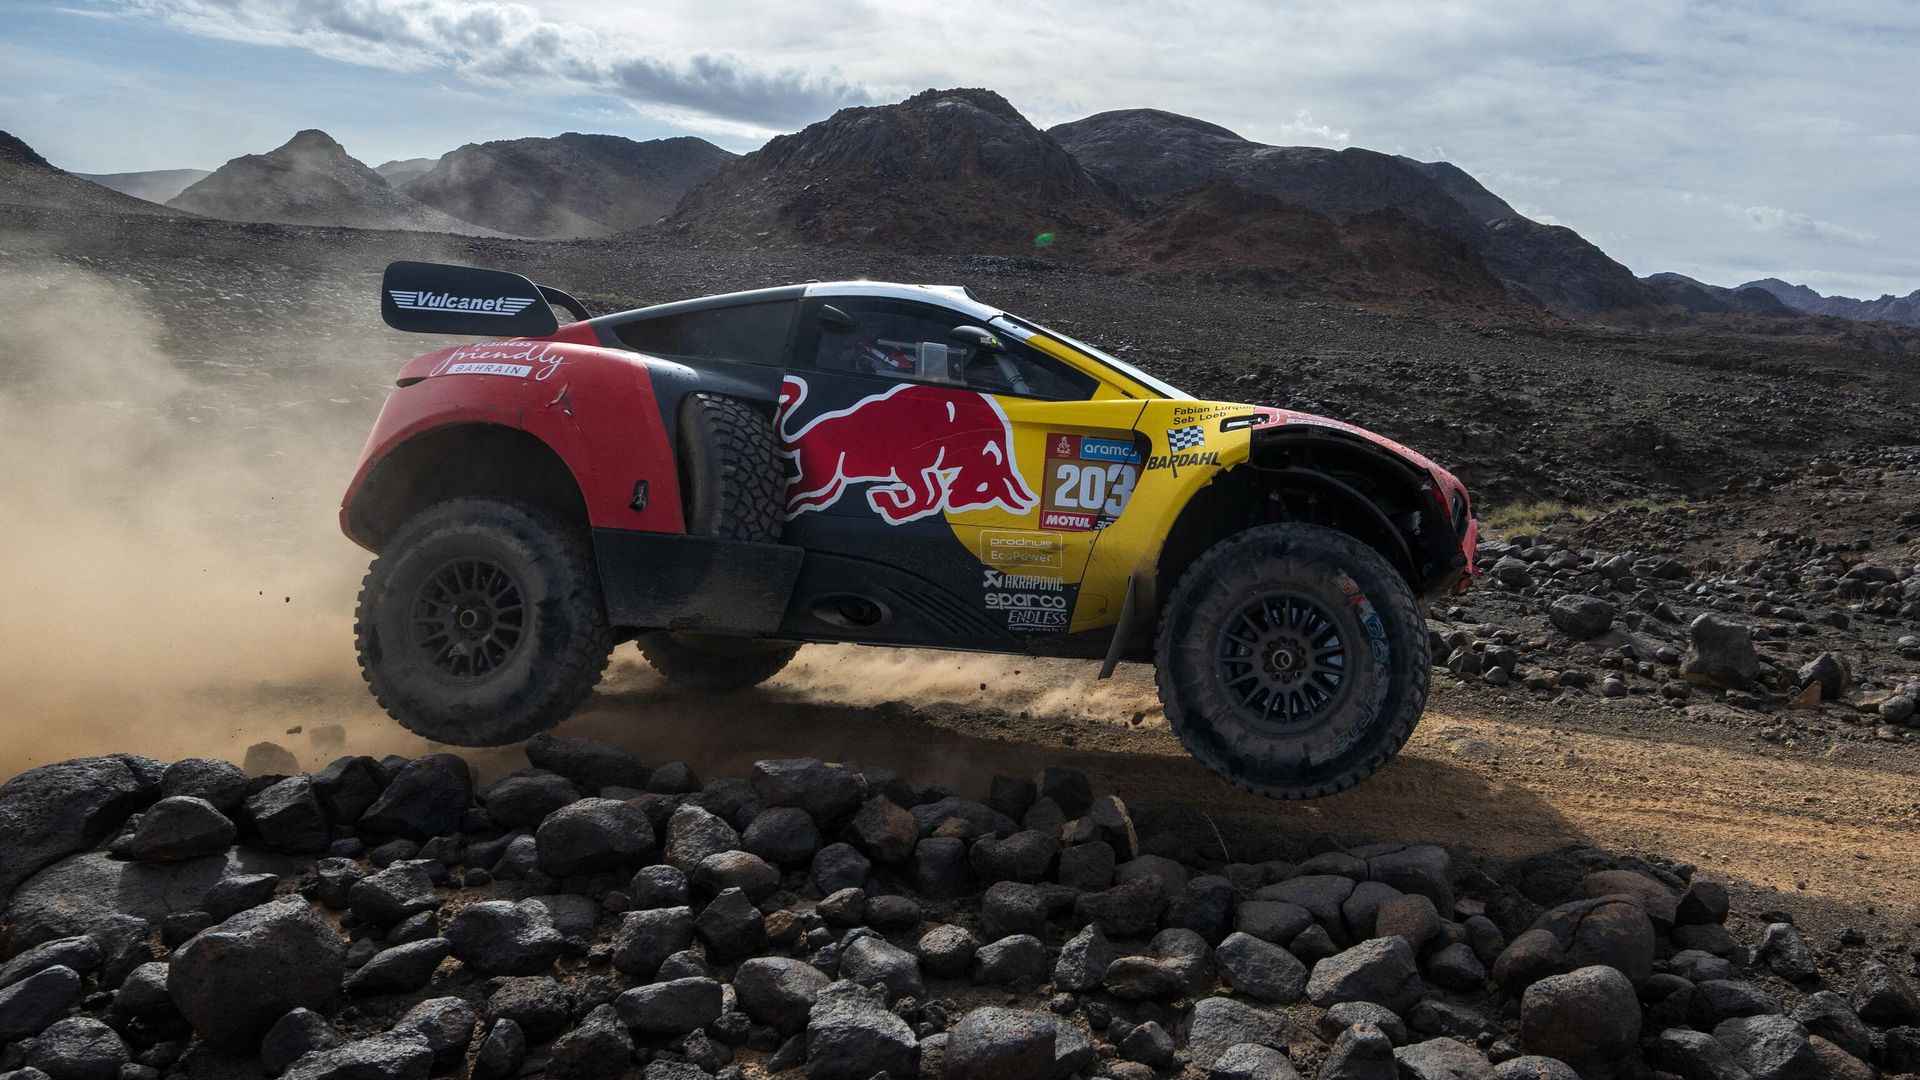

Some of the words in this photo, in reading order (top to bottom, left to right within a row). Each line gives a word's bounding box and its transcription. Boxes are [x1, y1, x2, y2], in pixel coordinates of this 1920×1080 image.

[416, 290, 505, 312] Vulcanet
[429, 343, 566, 381] friendly
[455, 364, 522, 375] BAHRAIN
[1173, 416, 1195, 425] Seb
[1199, 411, 1227, 421] Loeb
[1174, 406, 1210, 416] Fabian
[1084, 443, 1138, 458] aramco
[1147, 452, 1222, 472] BARDAHL
[1054, 463, 1137, 517] 203
[1045, 514, 1091, 528] MOTUL
[990, 537, 1053, 548] prodrive
[990, 550, 1053, 563] EcoPower
[984, 592, 1067, 611] sparco
[1007, 609, 1067, 625] ENDLESS
